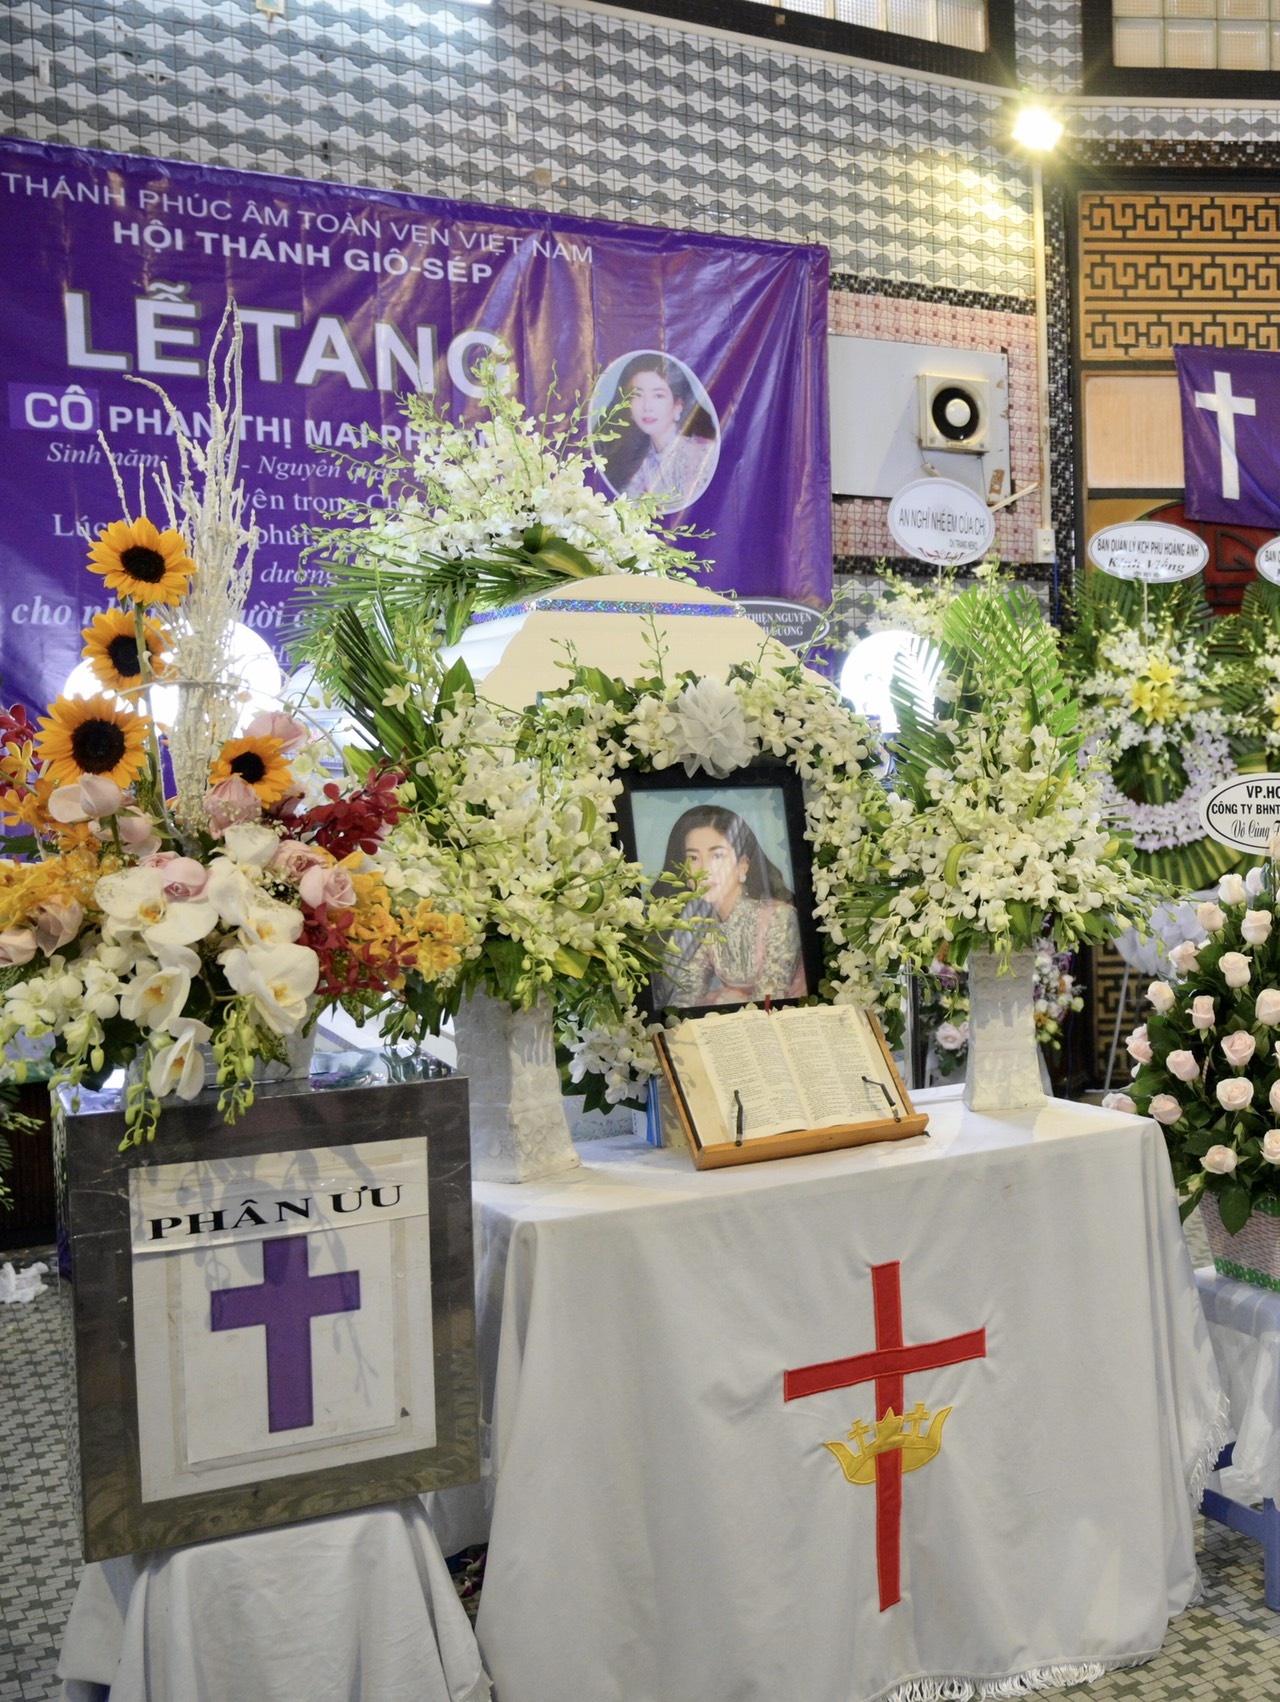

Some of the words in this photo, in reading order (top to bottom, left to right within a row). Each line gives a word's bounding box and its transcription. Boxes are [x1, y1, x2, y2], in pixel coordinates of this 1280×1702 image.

[1, 171, 126, 207] THÁNH
[139, 189, 232, 222] PHÚC
[242, 200, 290, 228] ÂM
[298, 210, 382, 239] TOÀN
[391, 221, 450, 248] VẸN
[459, 229, 524, 257] VIỆT
[533, 237, 594, 264] NAM
[114, 218, 185, 255] HỘI
[195, 230, 331, 268] THÁNH
[344, 247, 493, 285] GIÔ-SÉP
[64, 282, 205, 377] LỄ
[236, 308, 515, 402] TANG
[25, 384, 94, 431] CÔ
[238, 414, 292, 449] THỊ
[304, 419, 370, 450] MAI
[46, 442, 101, 466] Sinh
[258, 455, 342, 482] Nguyên
[899, 508, 910, 527] AN
[11, 595, 72, 626] cho
[1211, 801, 1238, 815] CÔNG
[1240, 803, 1253, 815] TY
[1256, 804, 1280, 815] BHNT
[147, 1198, 313, 1241] PHÂN
[329, 1184, 404, 1213] ƯU
